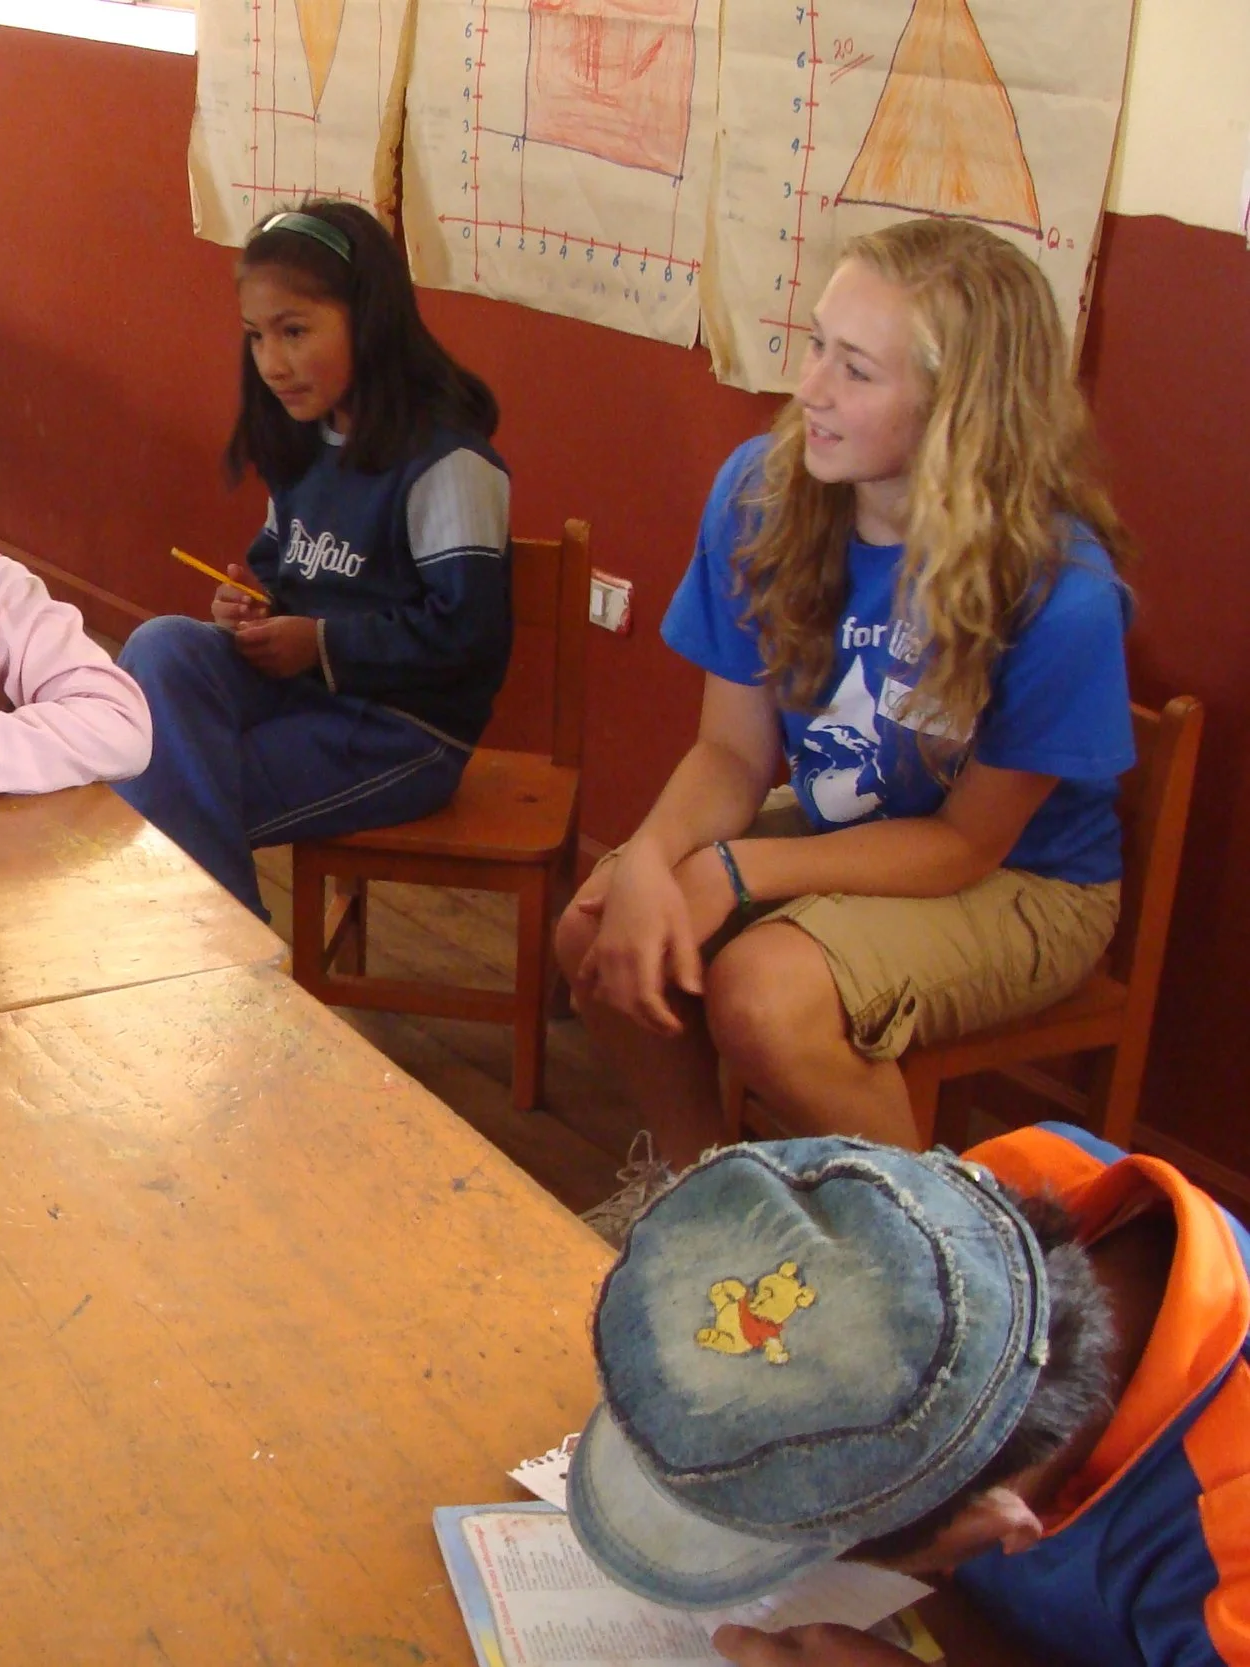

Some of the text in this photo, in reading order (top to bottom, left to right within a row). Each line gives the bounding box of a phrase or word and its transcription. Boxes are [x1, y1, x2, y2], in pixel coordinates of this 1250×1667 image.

[796, 6, 805, 25] 7
[465, 22, 474, 39] 6
[833, 37, 855, 61] 20
[464, 57, 473, 73] 5
[796, 50, 806, 69] 6
[793, 97, 803, 114] 5
[462, 118, 470, 134] 3
[511, 136, 521, 152] A
[461, 149, 469, 164] 2
[461, 180, 469, 195] 1
[784, 182, 792, 198] 3
[779, 228, 788, 241] 2
[495, 235, 502, 249] 1
[517, 237, 526, 251] 2
[539, 240, 547, 255] 3
[585, 248, 595, 263] 5
[612, 252, 621, 268] 6
[664, 264, 673, 283] 8
[774, 274, 783, 291] 1
[841, 616, 888, 650] for
